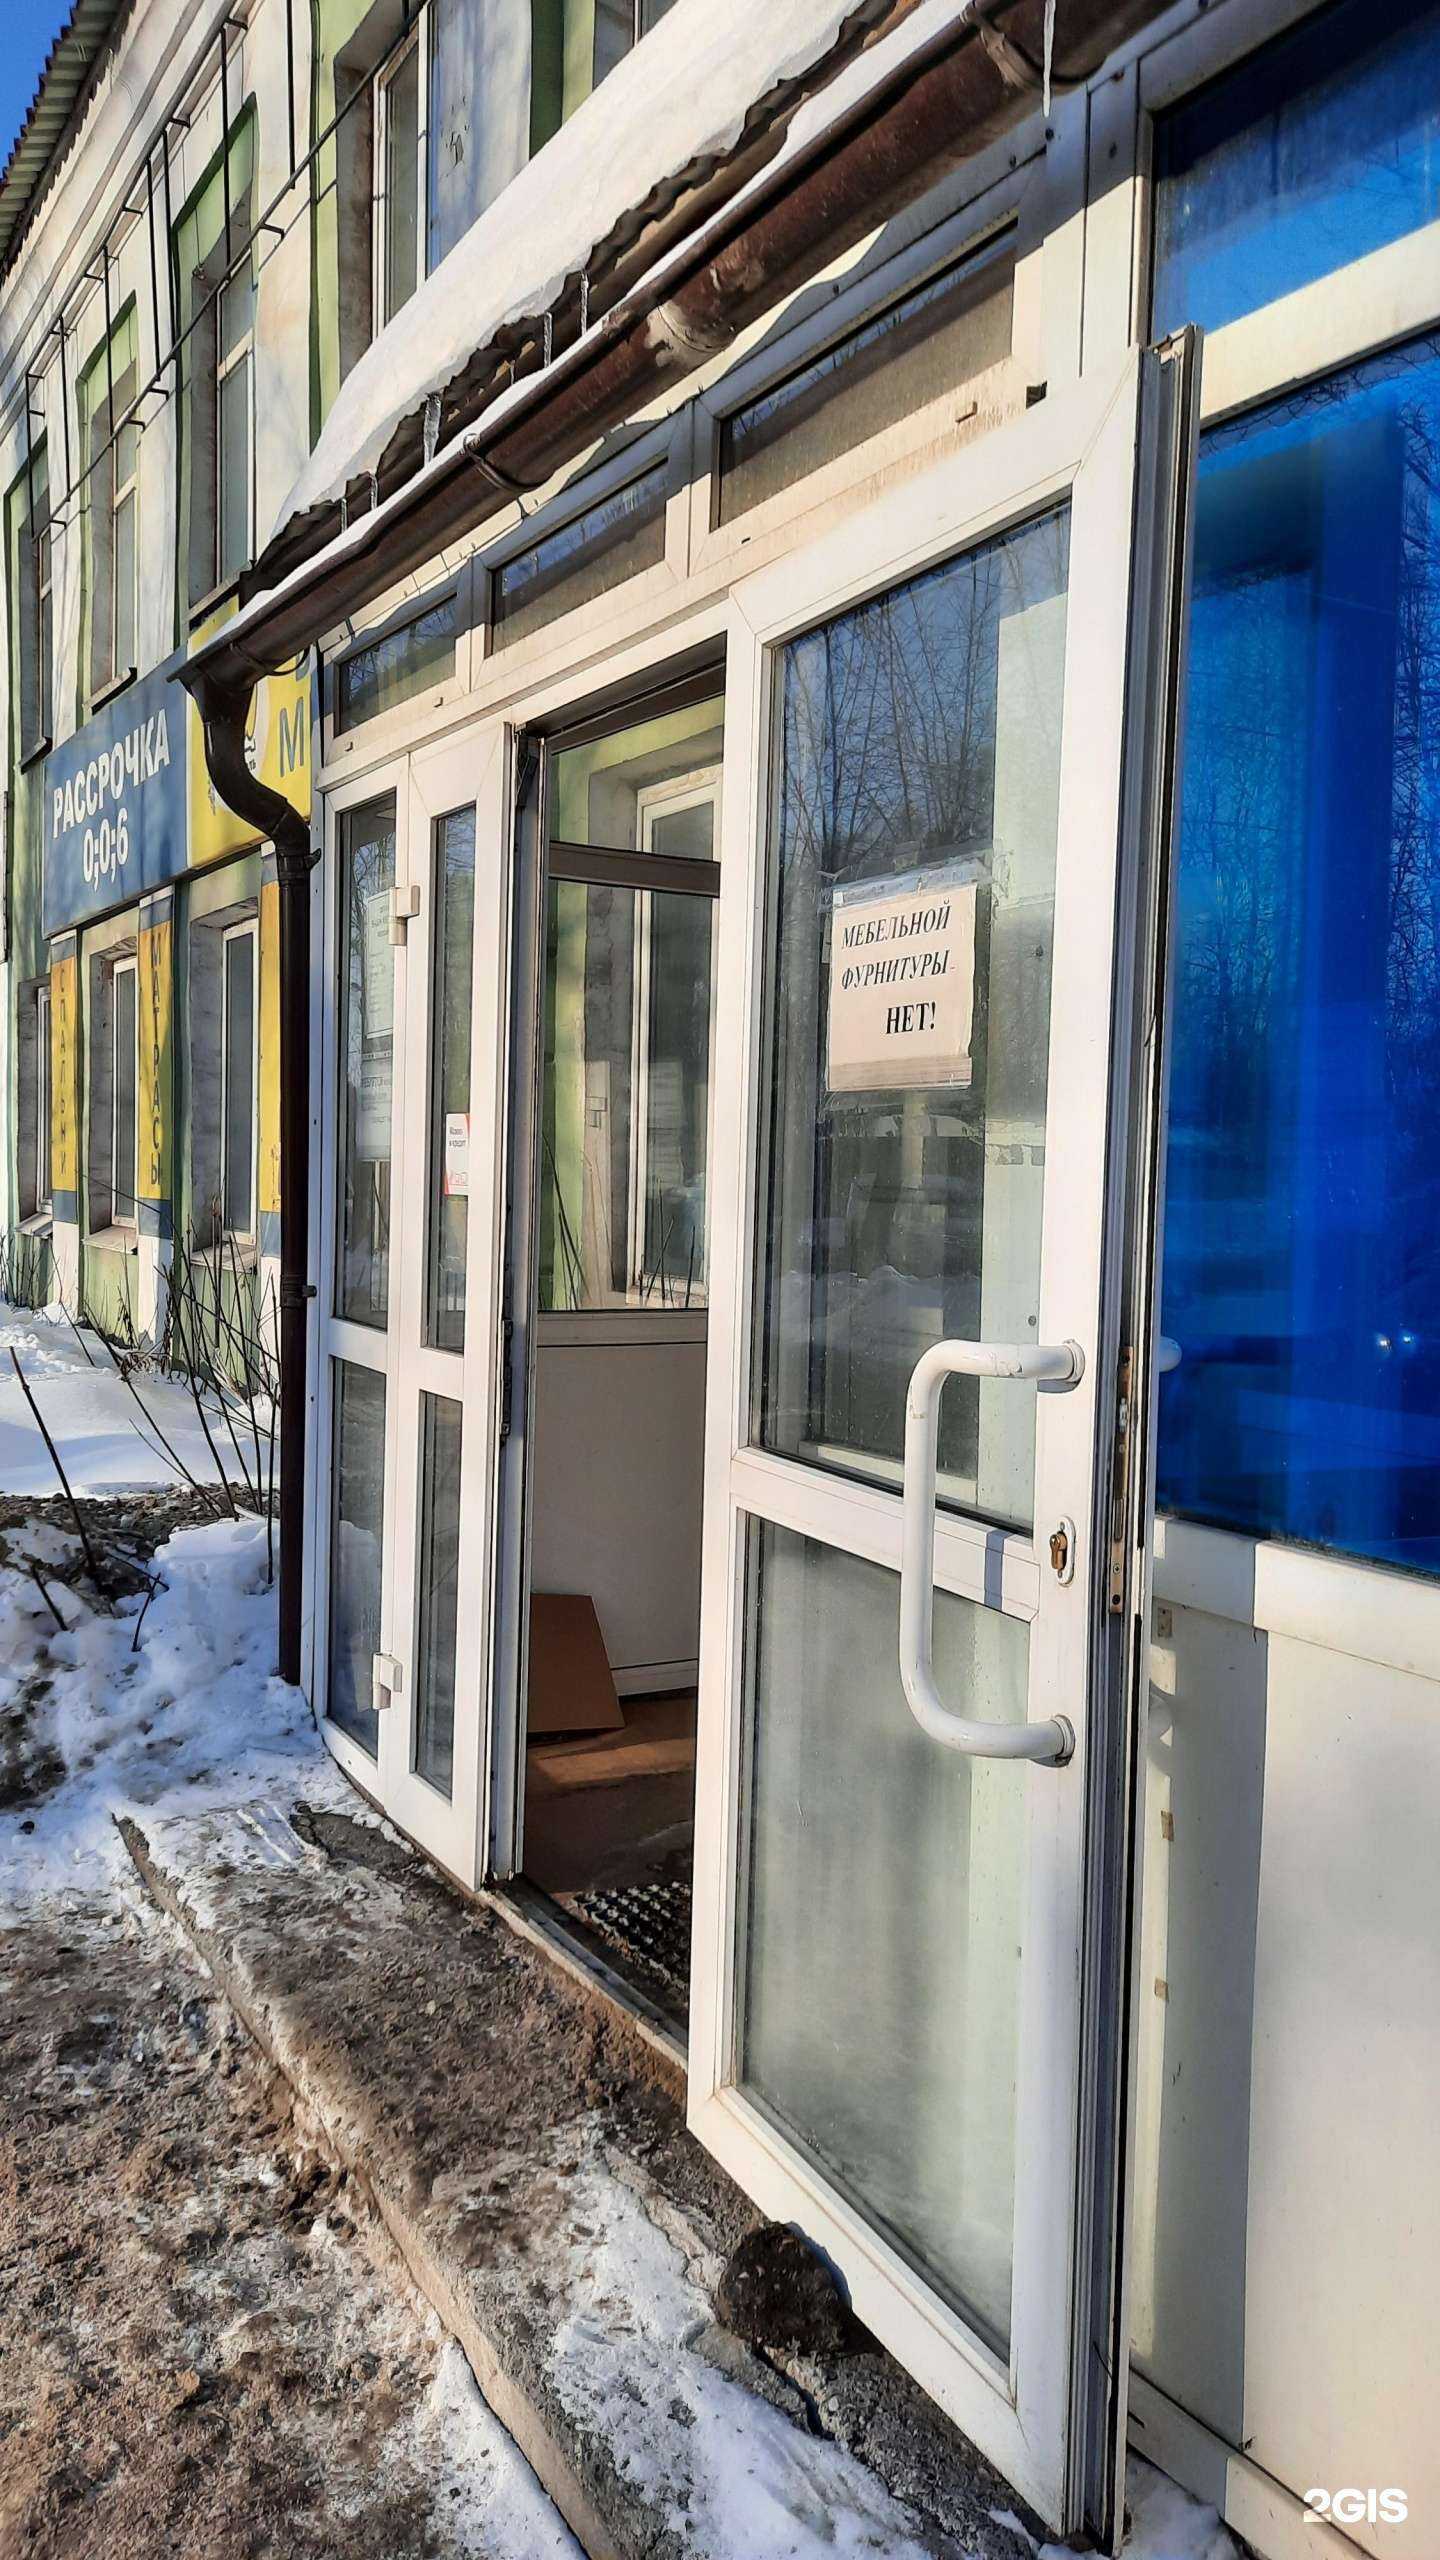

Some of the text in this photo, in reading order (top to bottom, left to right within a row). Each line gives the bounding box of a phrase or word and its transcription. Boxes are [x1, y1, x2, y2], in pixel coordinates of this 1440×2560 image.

[53, 708, 170, 839] РАССРОЧКА
[83, 807, 129, 892] 0;0;6
[841, 899, 951, 950] МЕБЕЛЬНОЙ
[150, 931, 162, 1186] МАТРАСЫ
[885, 1001, 937, 1035] НЕТ!
